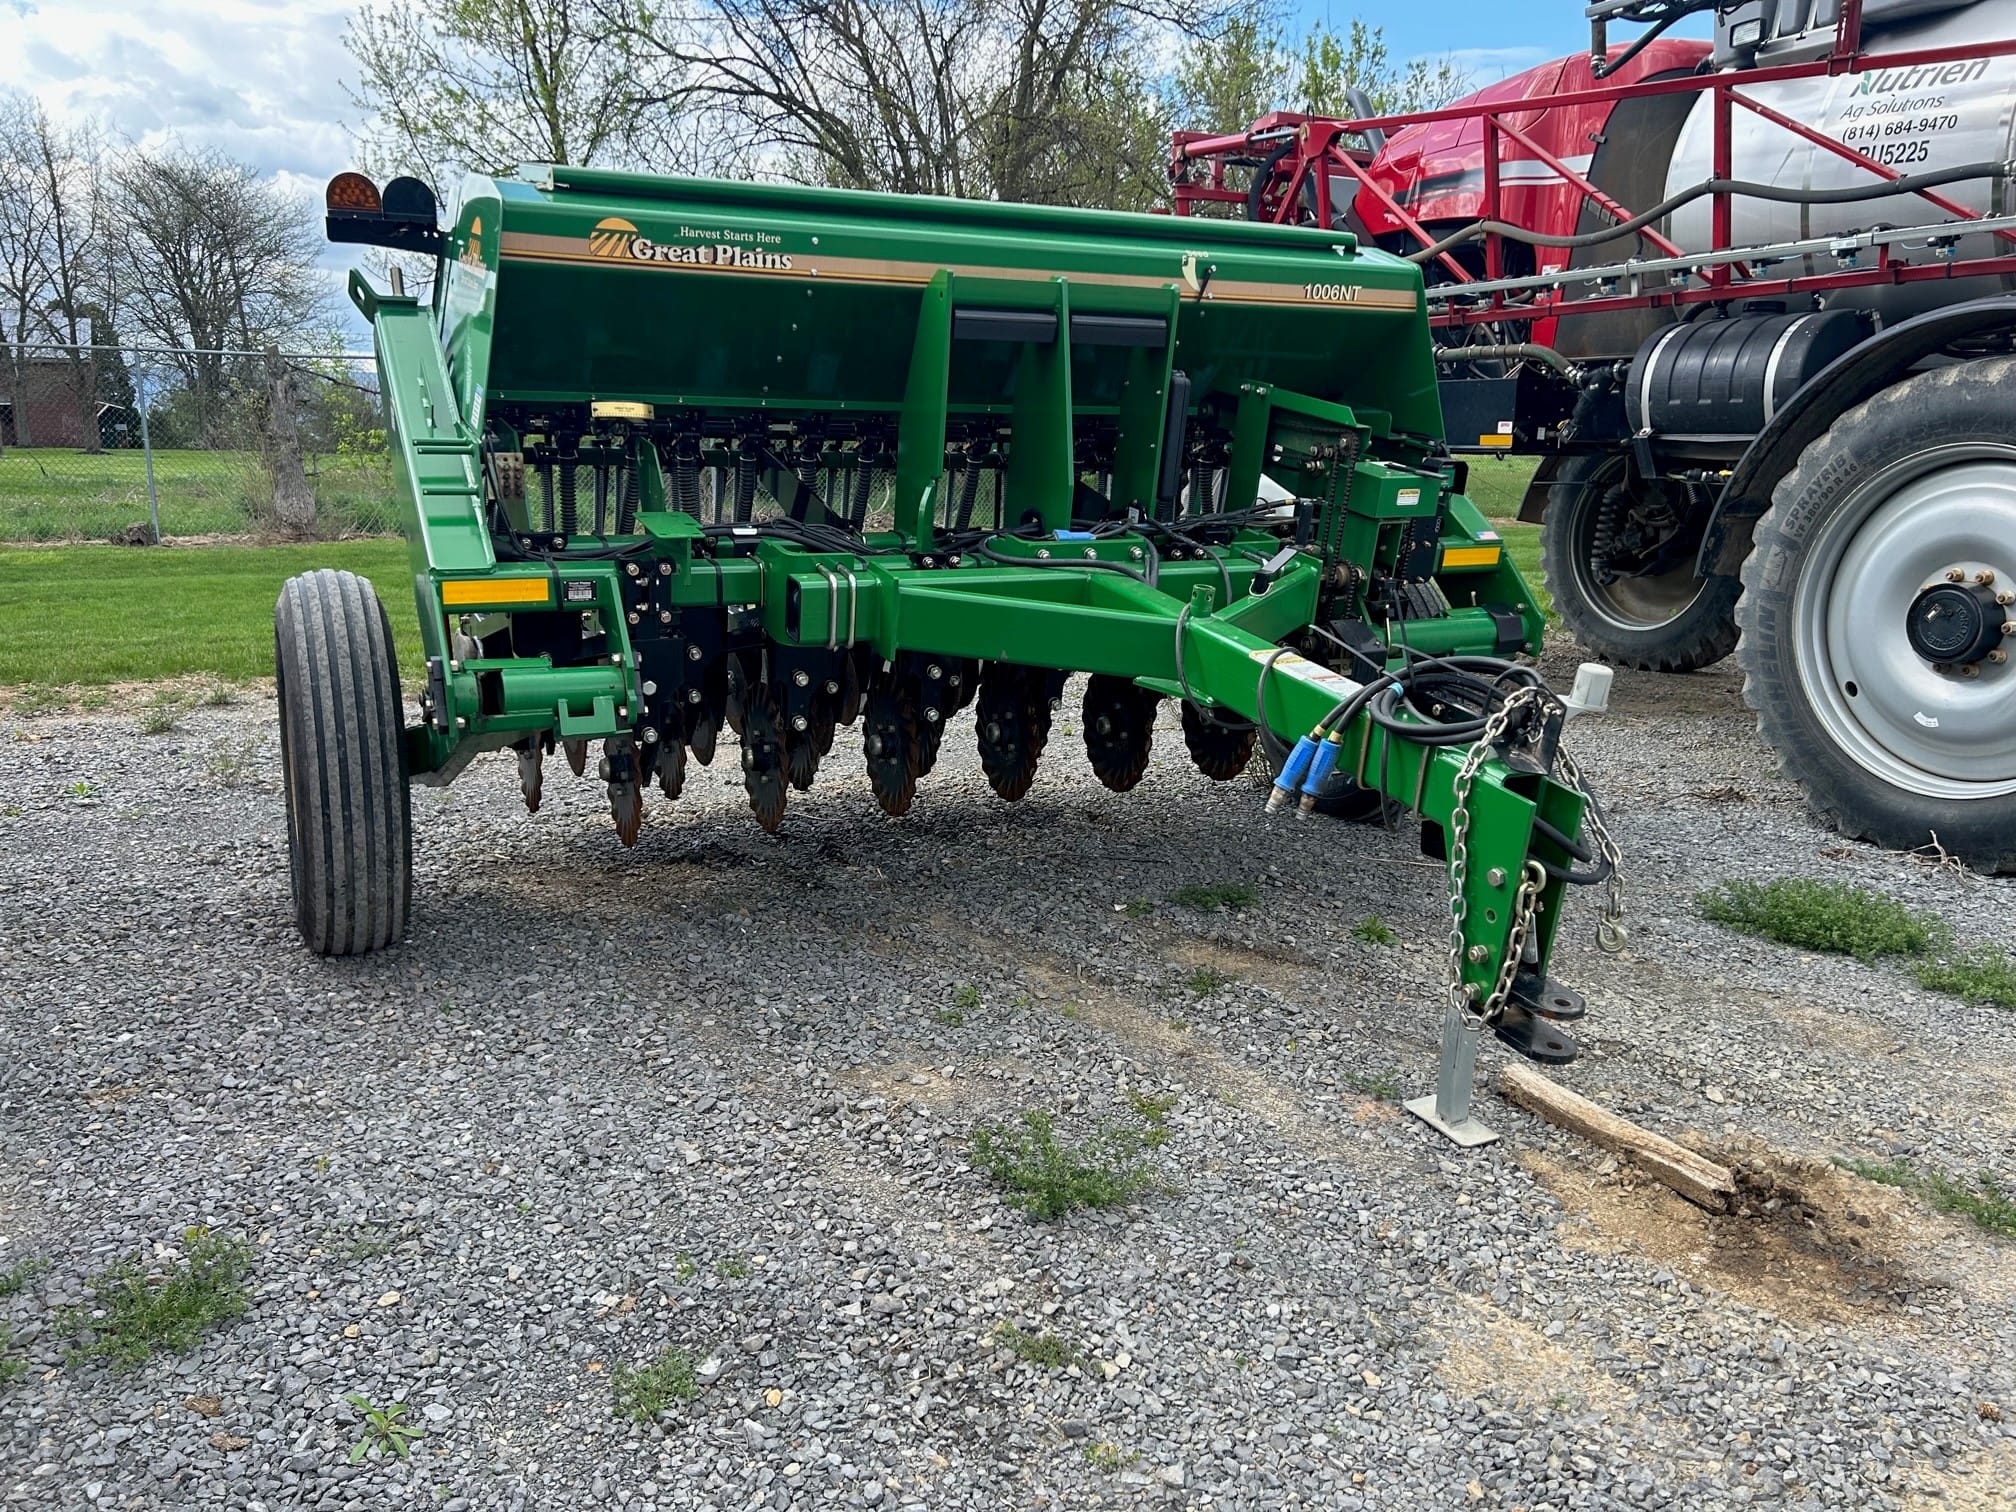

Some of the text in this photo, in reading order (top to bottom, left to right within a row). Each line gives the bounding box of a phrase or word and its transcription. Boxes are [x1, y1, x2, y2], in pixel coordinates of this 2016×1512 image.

[1849, 59, 1991, 98] Nutrien
[1840, 95, 1945, 122] Ag Solutions
[1842, 114, 1958, 144] (814) 684-9470
[680, 226, 781, 244] Harvest Starts Here
[630, 237, 794, 270] Great Plains
[1303, 282, 1363, 301] 1006NT
[1784, 454, 1847, 530] SPRAYBIB
[1803, 486, 1834, 522] 380/90
[1833, 476, 1843, 486] R
[1844, 463, 1858, 477] 46
